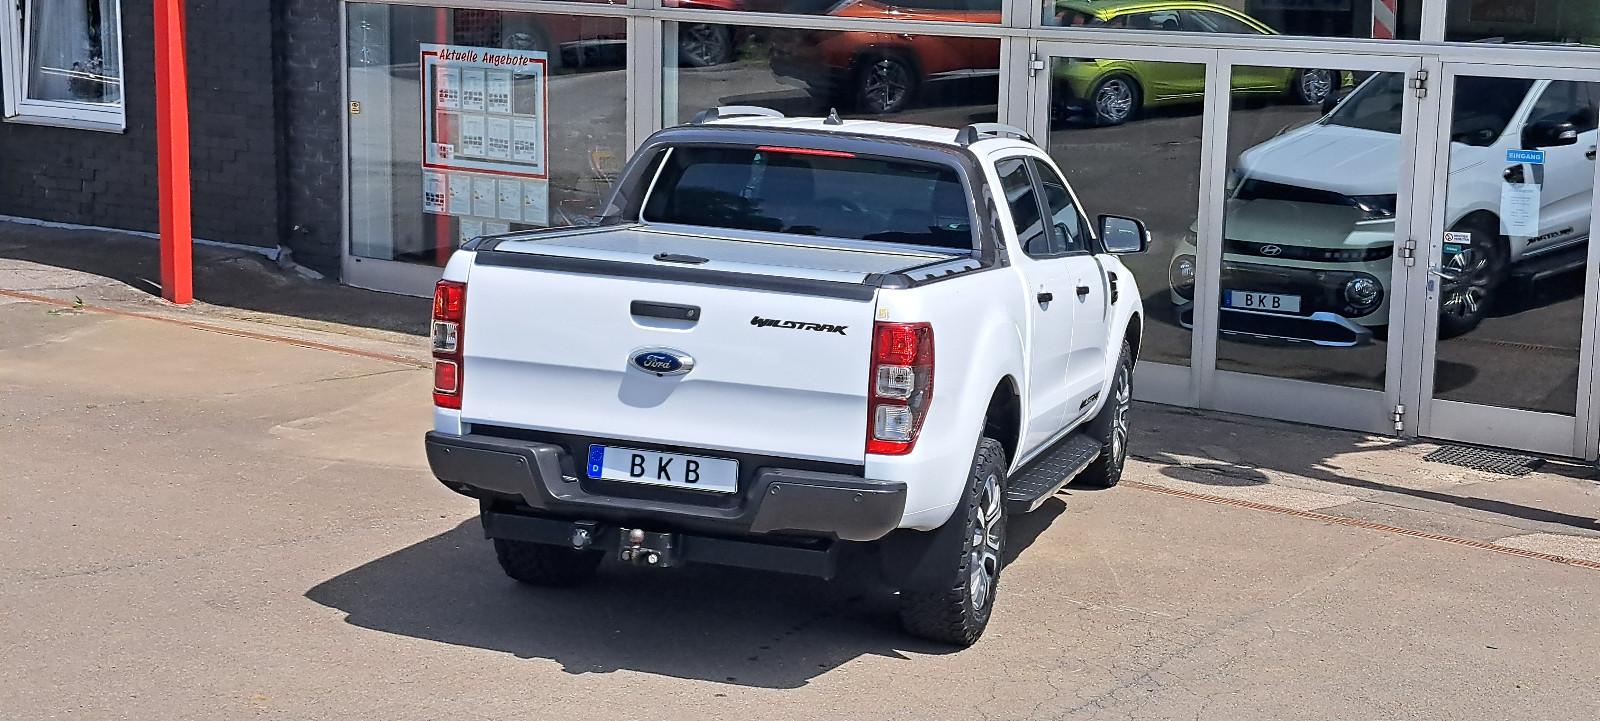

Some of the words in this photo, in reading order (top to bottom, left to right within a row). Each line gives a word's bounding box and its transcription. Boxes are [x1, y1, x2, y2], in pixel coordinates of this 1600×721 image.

[439, 48, 478, 63] Aktuelle
[482, 52, 529, 67] Angebote
[1509, 152, 1541, 160] EINGANG
[750, 315, 848, 336] WILDTRAK
[643, 354, 671, 369] Ford
[592, 464, 599, 472] D
